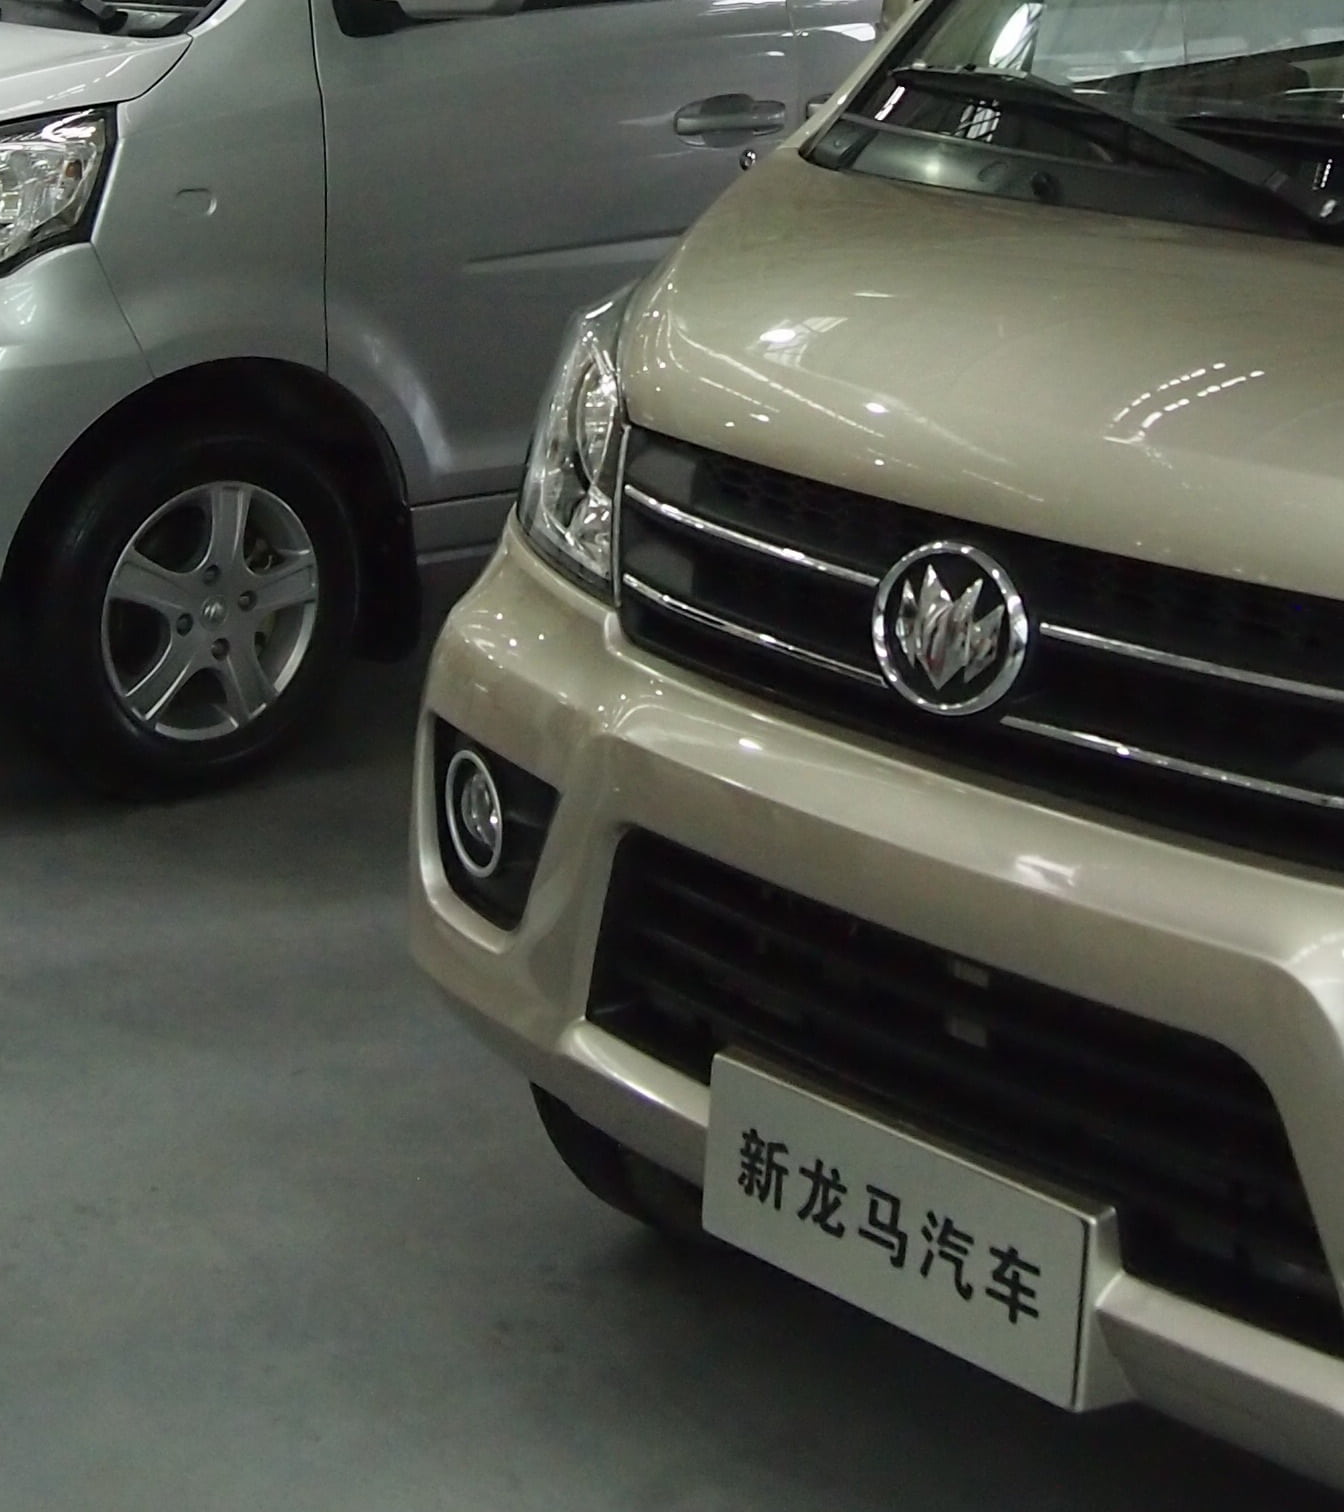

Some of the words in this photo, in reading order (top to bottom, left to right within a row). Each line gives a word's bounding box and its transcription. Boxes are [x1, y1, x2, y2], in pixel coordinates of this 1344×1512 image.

[737, 1128, 1041, 1324] 新龙马汽车
